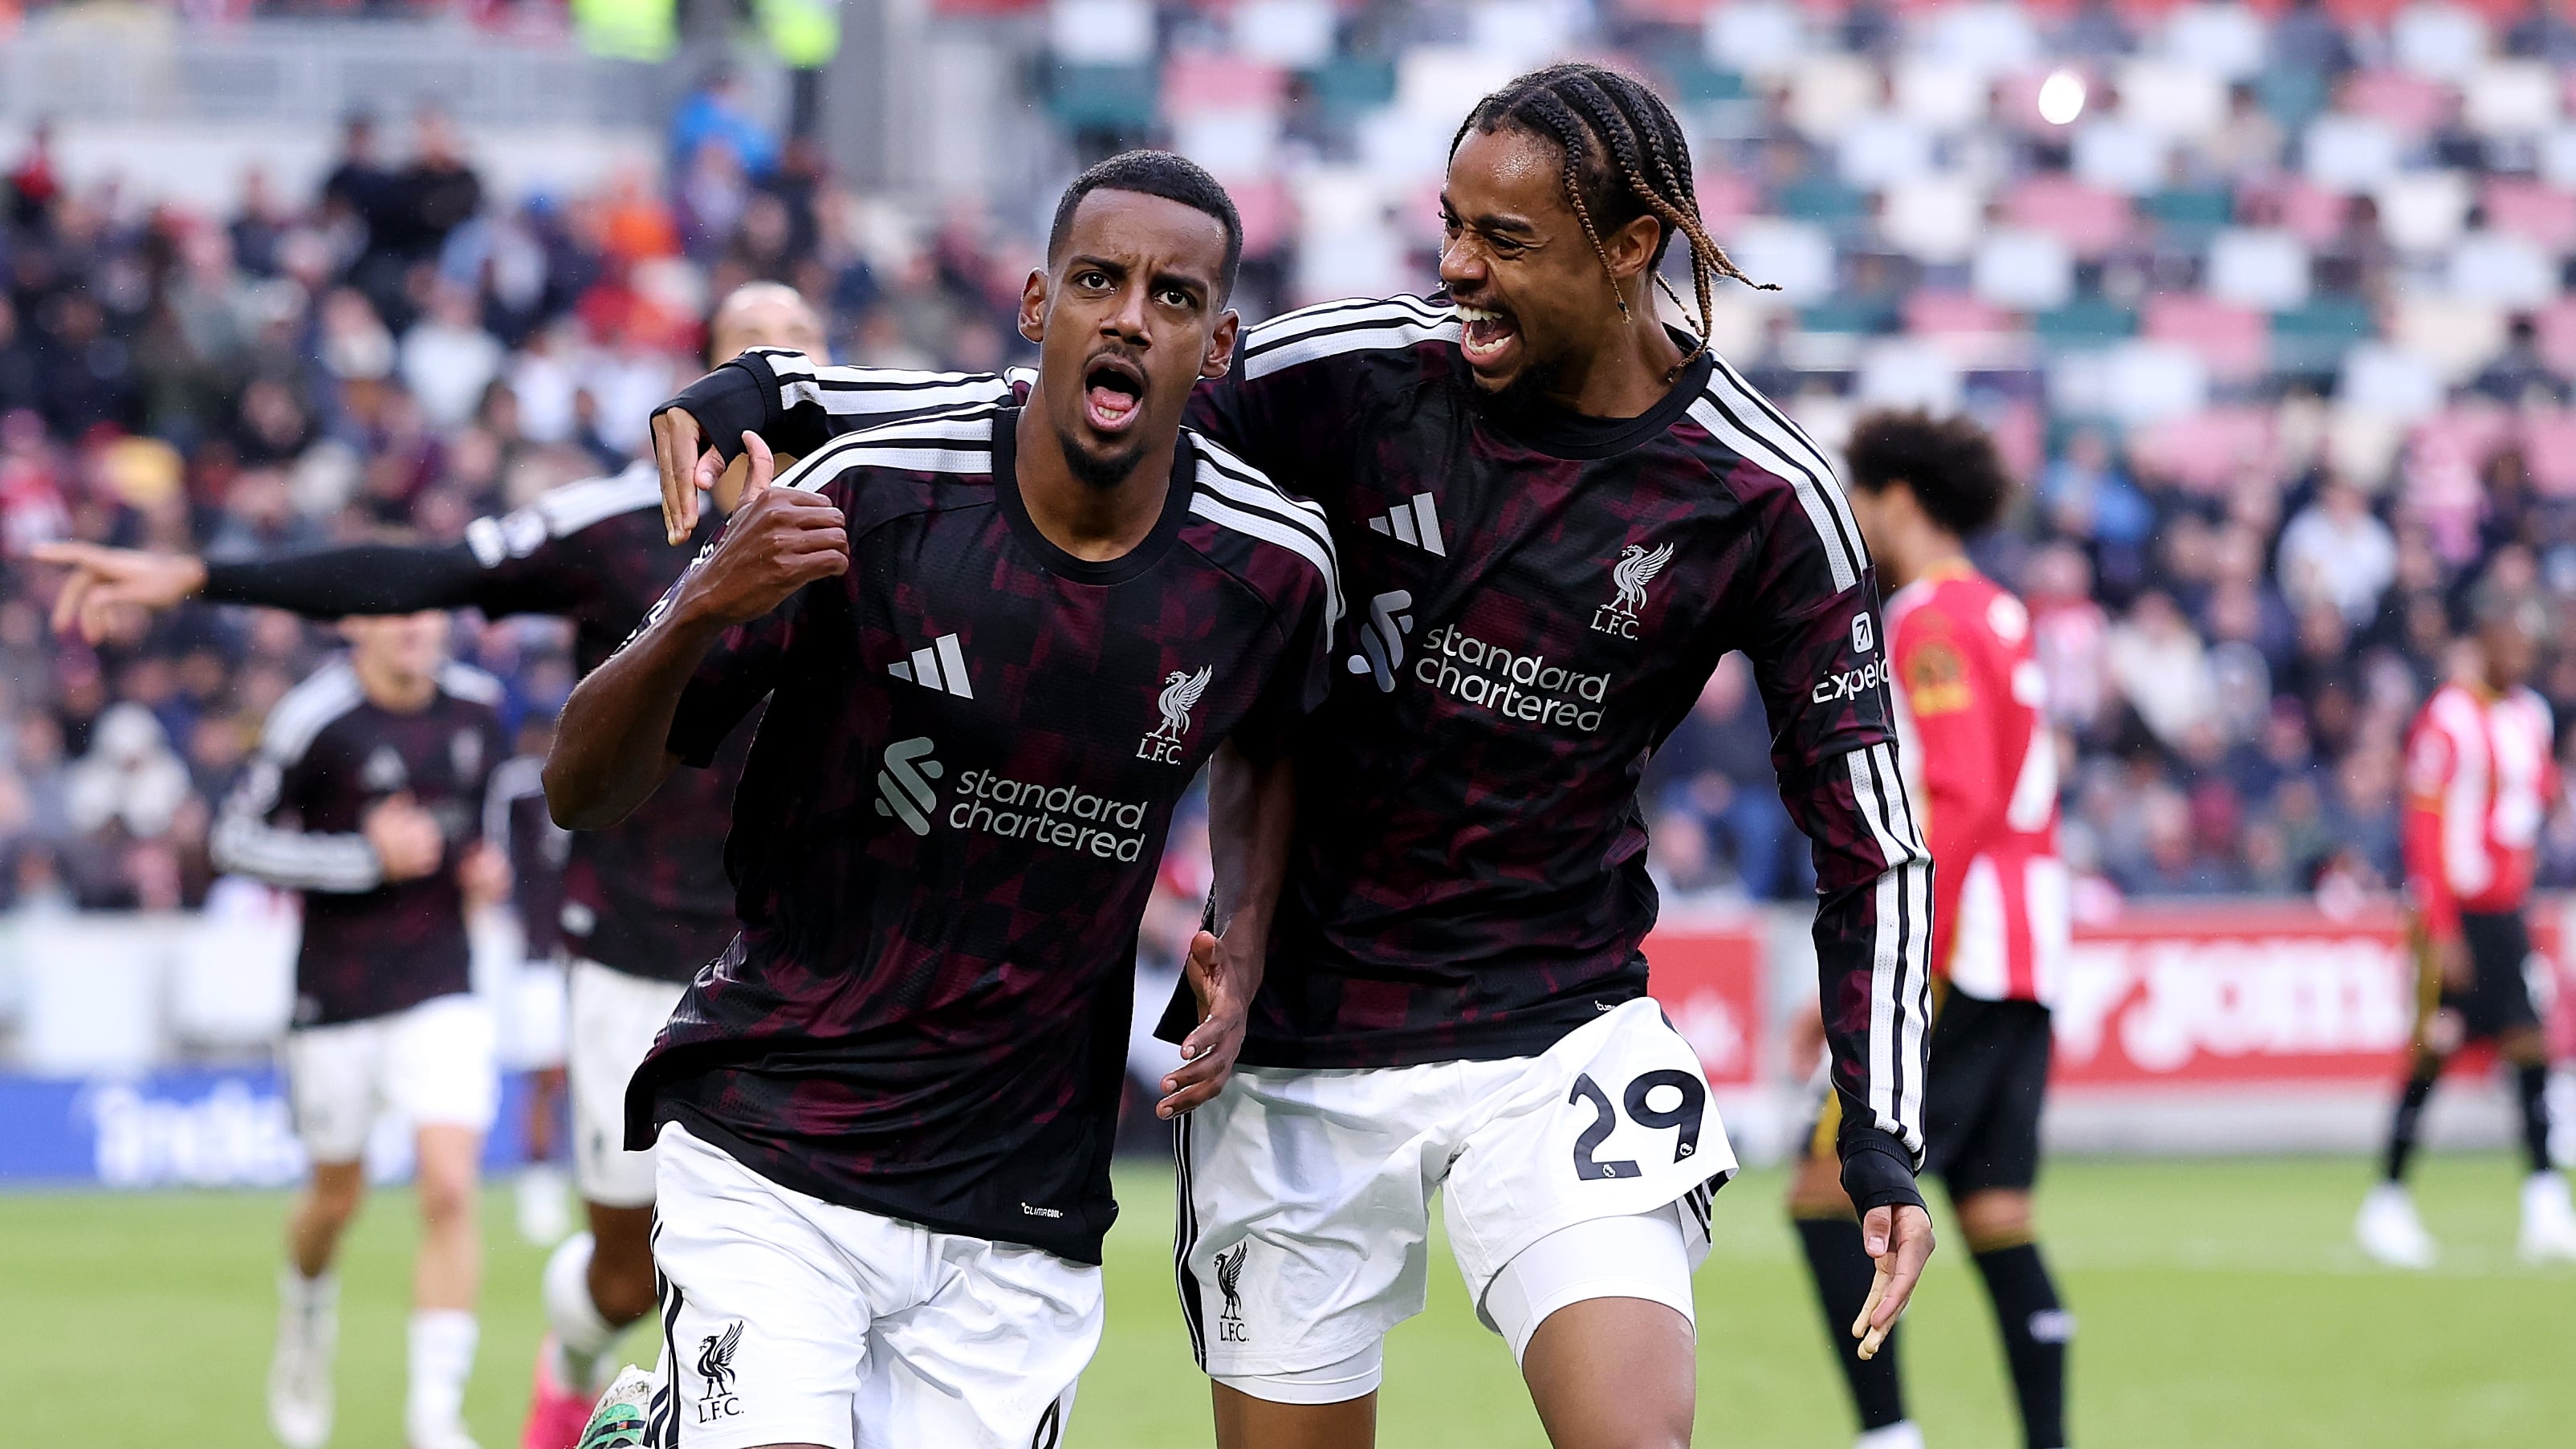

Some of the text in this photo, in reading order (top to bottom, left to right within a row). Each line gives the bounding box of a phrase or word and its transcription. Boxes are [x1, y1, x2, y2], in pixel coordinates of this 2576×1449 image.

[1590, 611, 1639, 641] L.F.C.
[1415, 657, 1606, 732] chartered
[1423, 624, 1610, 703] standard
[1136, 739, 1183, 766] L.F.C.
[956, 768, 1148, 830] standard
[949, 800, 1146, 863] chartered
[1569, 1069, 1706, 1181] 29
[1219, 1321, 1250, 1342] L.F.C.
[698, 1398, 744, 1424] L.F.C.
